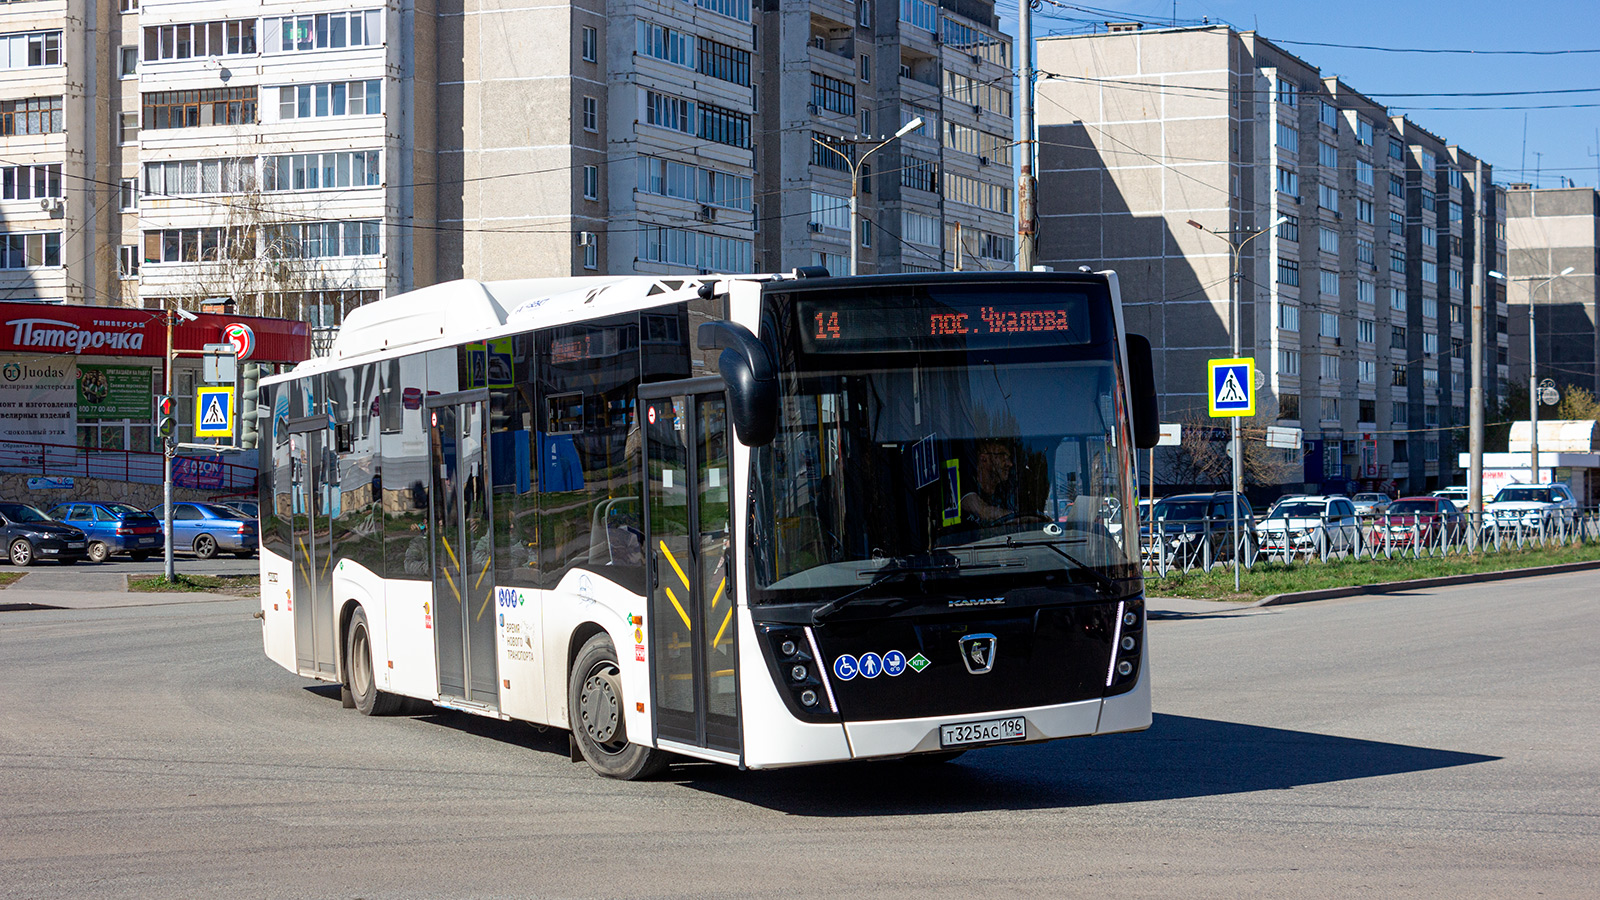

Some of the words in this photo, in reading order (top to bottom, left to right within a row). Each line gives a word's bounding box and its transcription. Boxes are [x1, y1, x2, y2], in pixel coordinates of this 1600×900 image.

[815, 311, 840, 339] 14
[22, 365, 64, 380] Juodas
[40, 411, 71, 419] изделий
[190, 460, 219, 474] OZON
[948, 597, 1006, 608] KAMAZ
[506, 623, 520, 633] ВРЕМЯ
[506, 636, 523, 647] НОВОГО
[507, 649, 535, 662] ТРАНСПОРТА
[1001, 719, 1023, 732] 196
